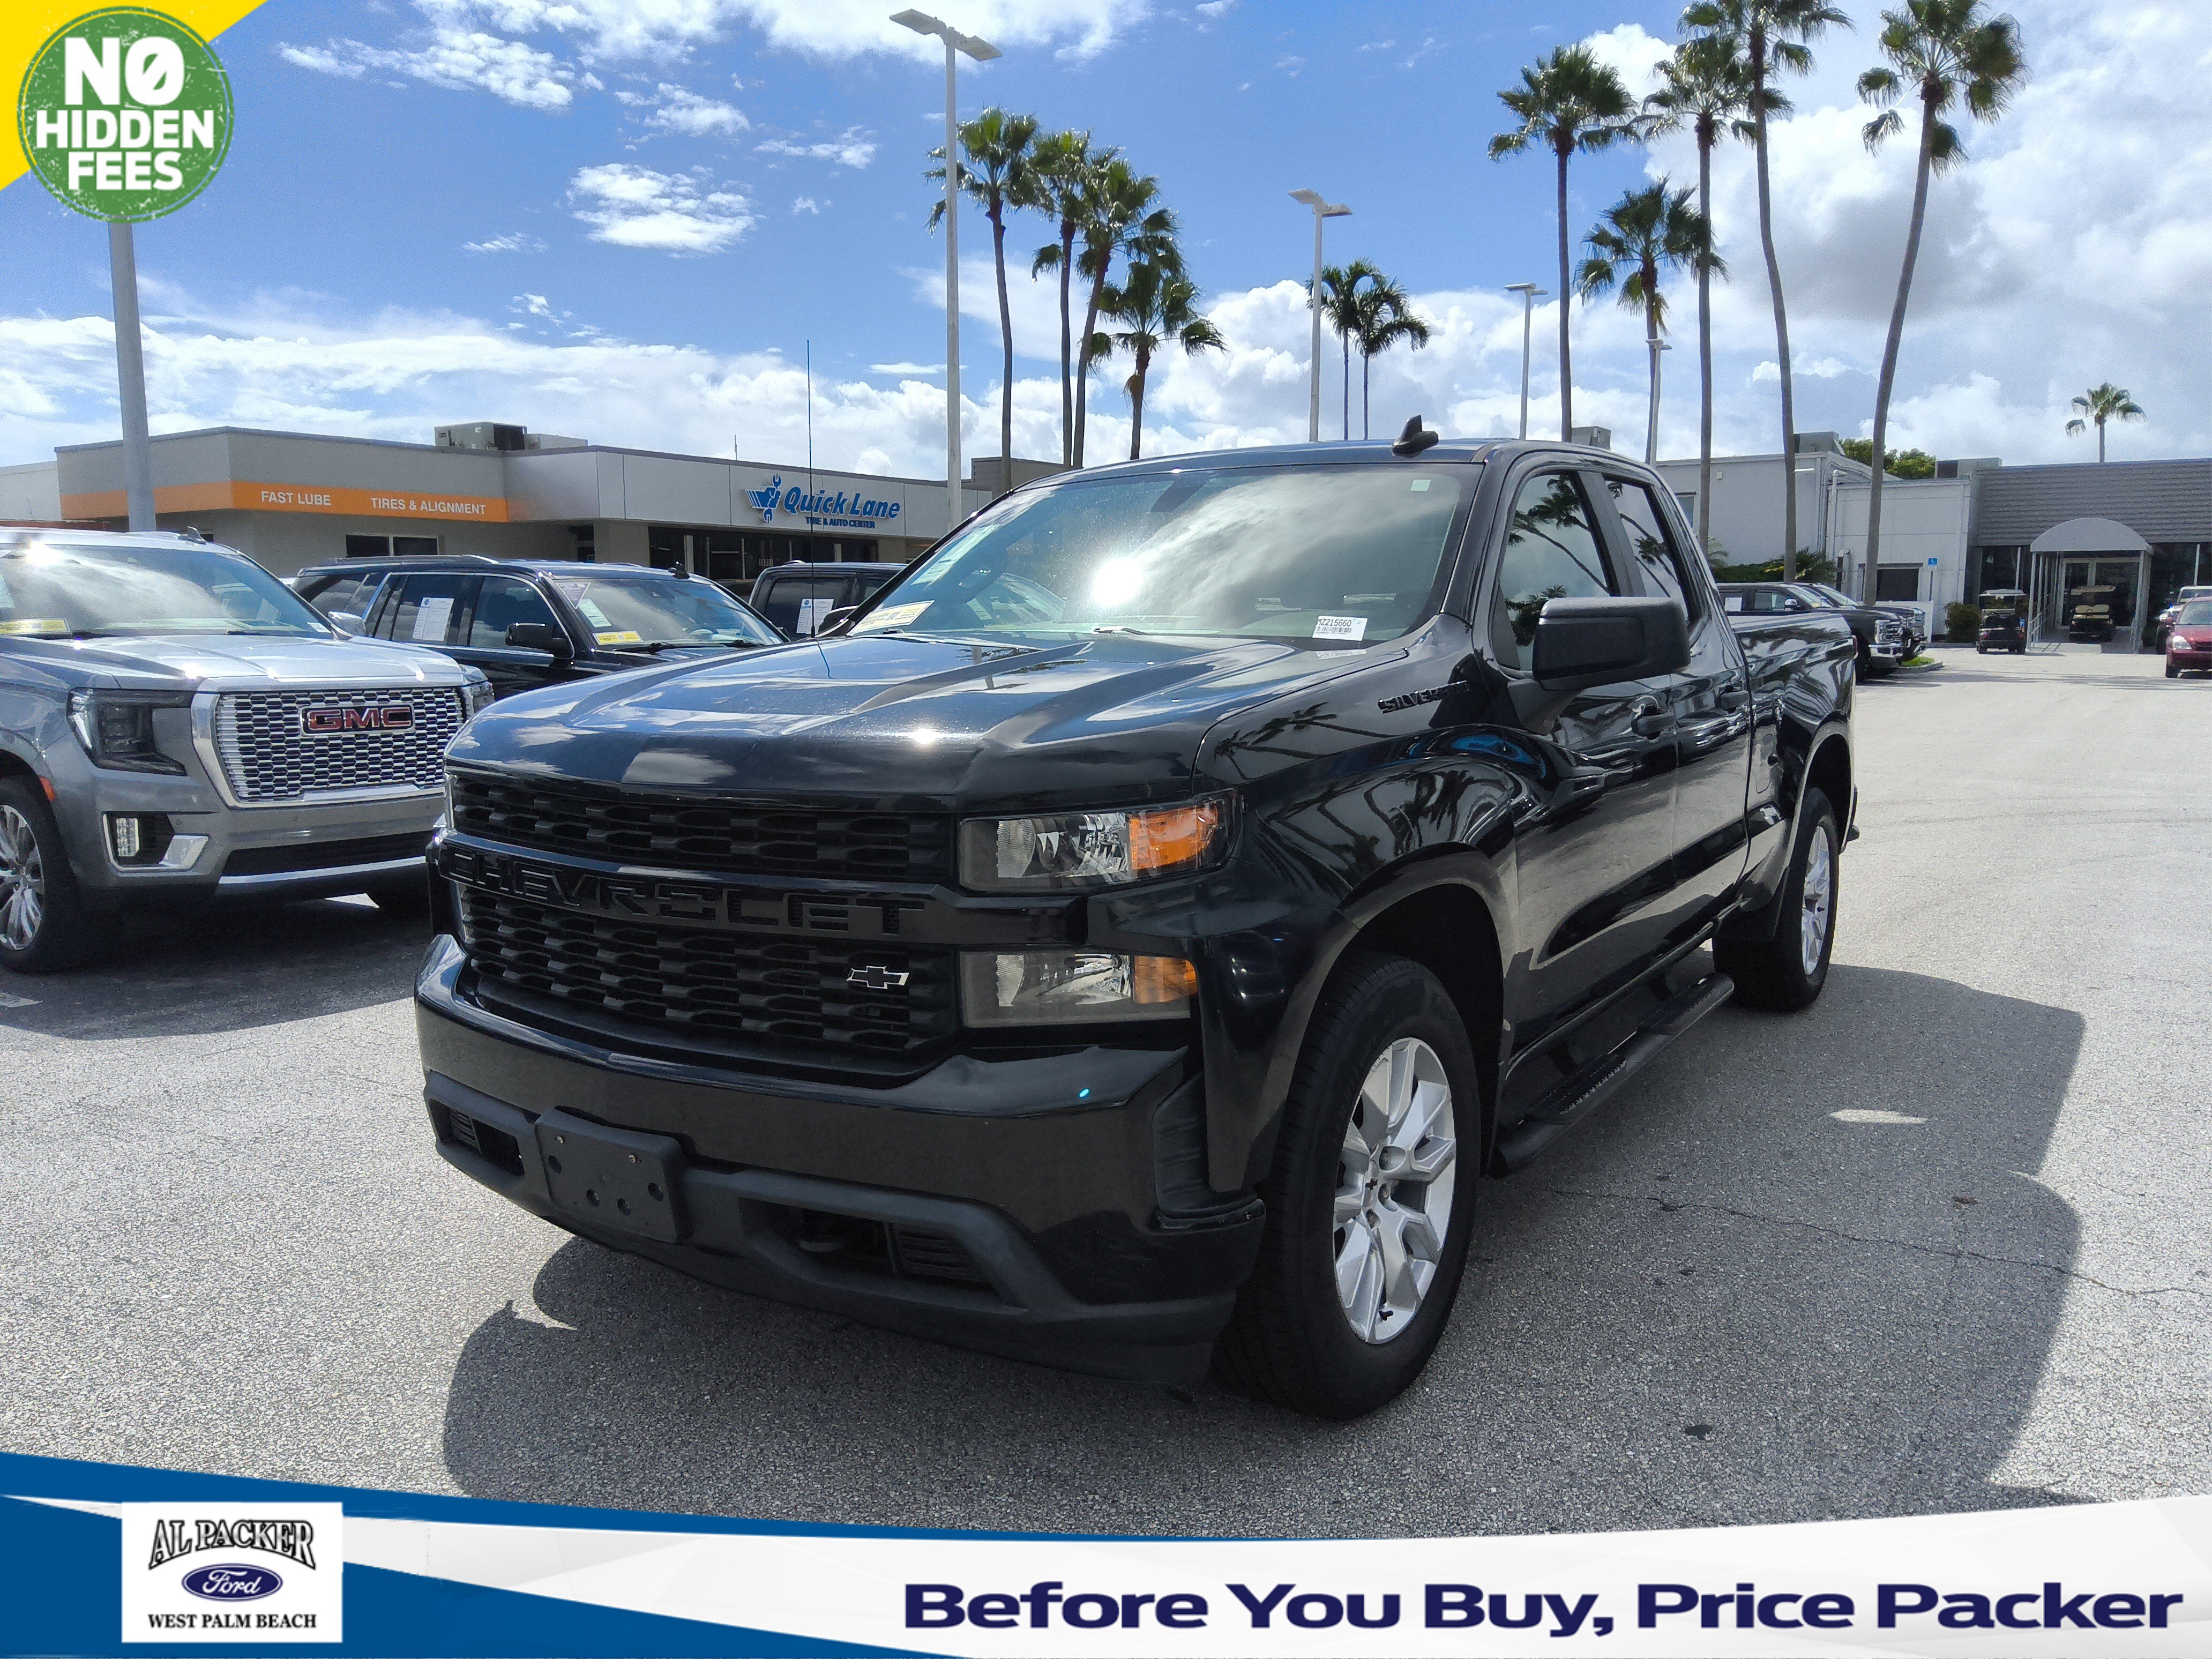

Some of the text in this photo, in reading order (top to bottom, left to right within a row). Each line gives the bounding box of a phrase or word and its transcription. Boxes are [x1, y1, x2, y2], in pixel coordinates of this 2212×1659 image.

[261, 491, 331, 506] FAST LUBE
[371, 497, 485, 514] TIRES & ALIGNMENT
[783, 486, 900, 519] Quick Lane
[829, 518, 848, 527] AUTO
[849, 519, 876, 528] CENTER
[307, 707, 411, 730] GMC
[440, 845, 925, 936] CHEVROLET
